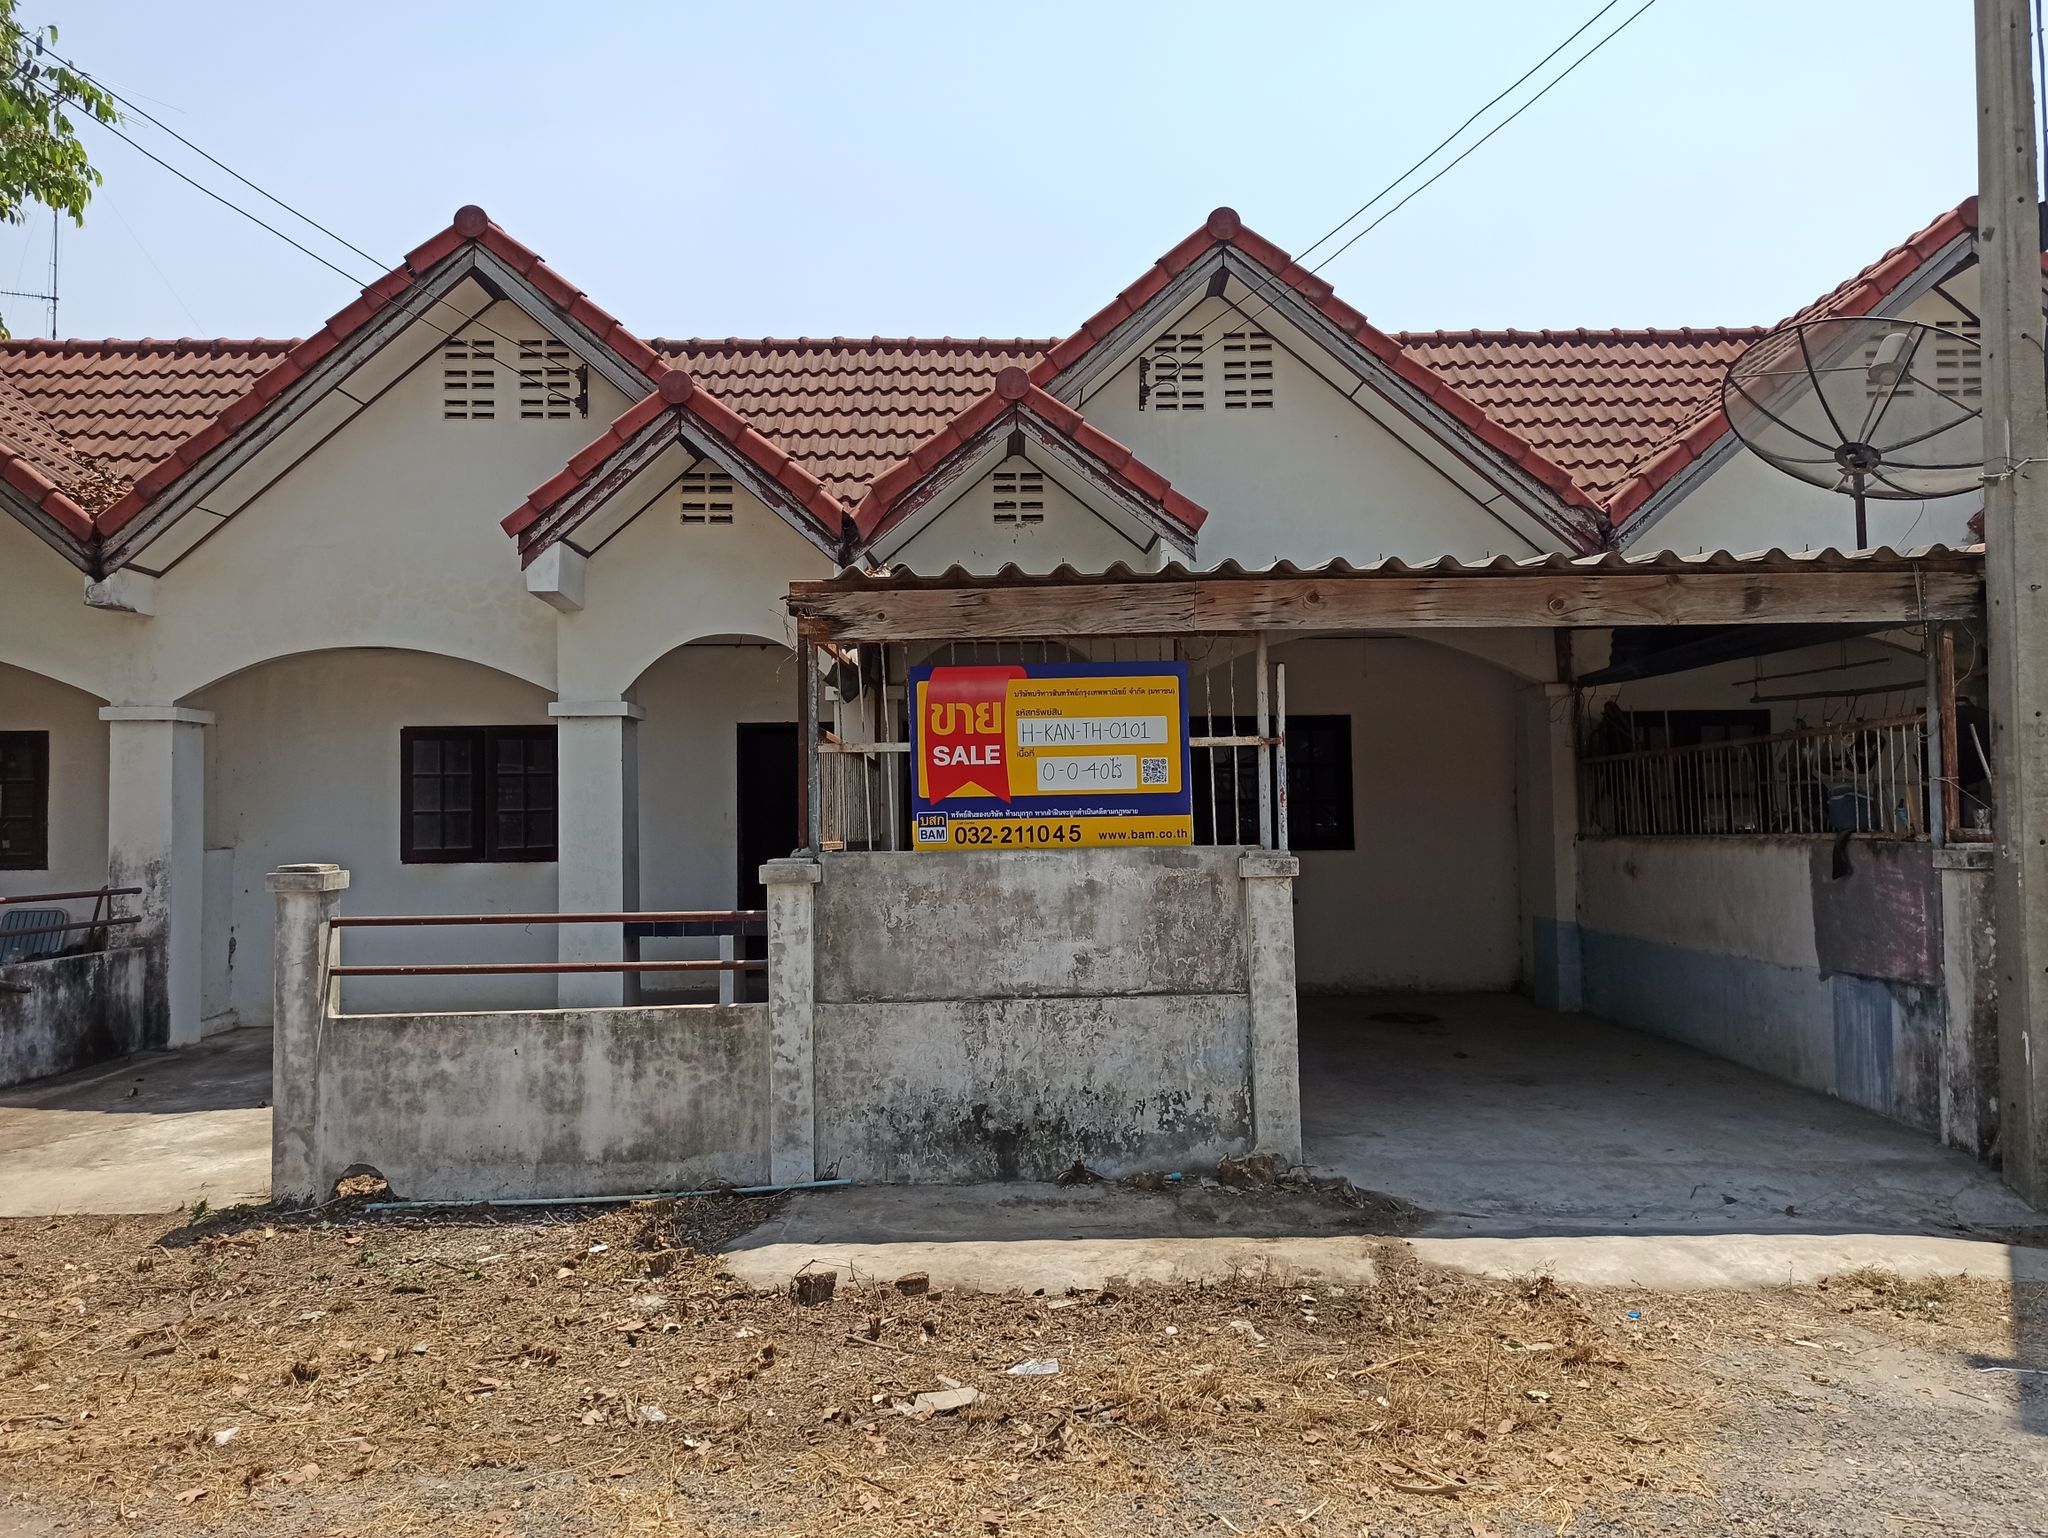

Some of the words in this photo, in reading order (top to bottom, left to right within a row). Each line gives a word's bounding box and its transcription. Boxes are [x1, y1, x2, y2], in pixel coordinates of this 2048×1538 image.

[1015, 706, 1063, 717] รหัสทรัพย์สิน
[930, 702, 1002, 736] ขาย
[1021, 721, 1152, 743] H-KAN-TH-0101
[932, 744, 1001, 766] SALE
[1016, 747, 1035, 758] เนื้อที่
[919, 814, 945, 826] บสก
[920, 828, 945, 840] BAM
[1098, 828, 1188, 840] www.bam.co.th
